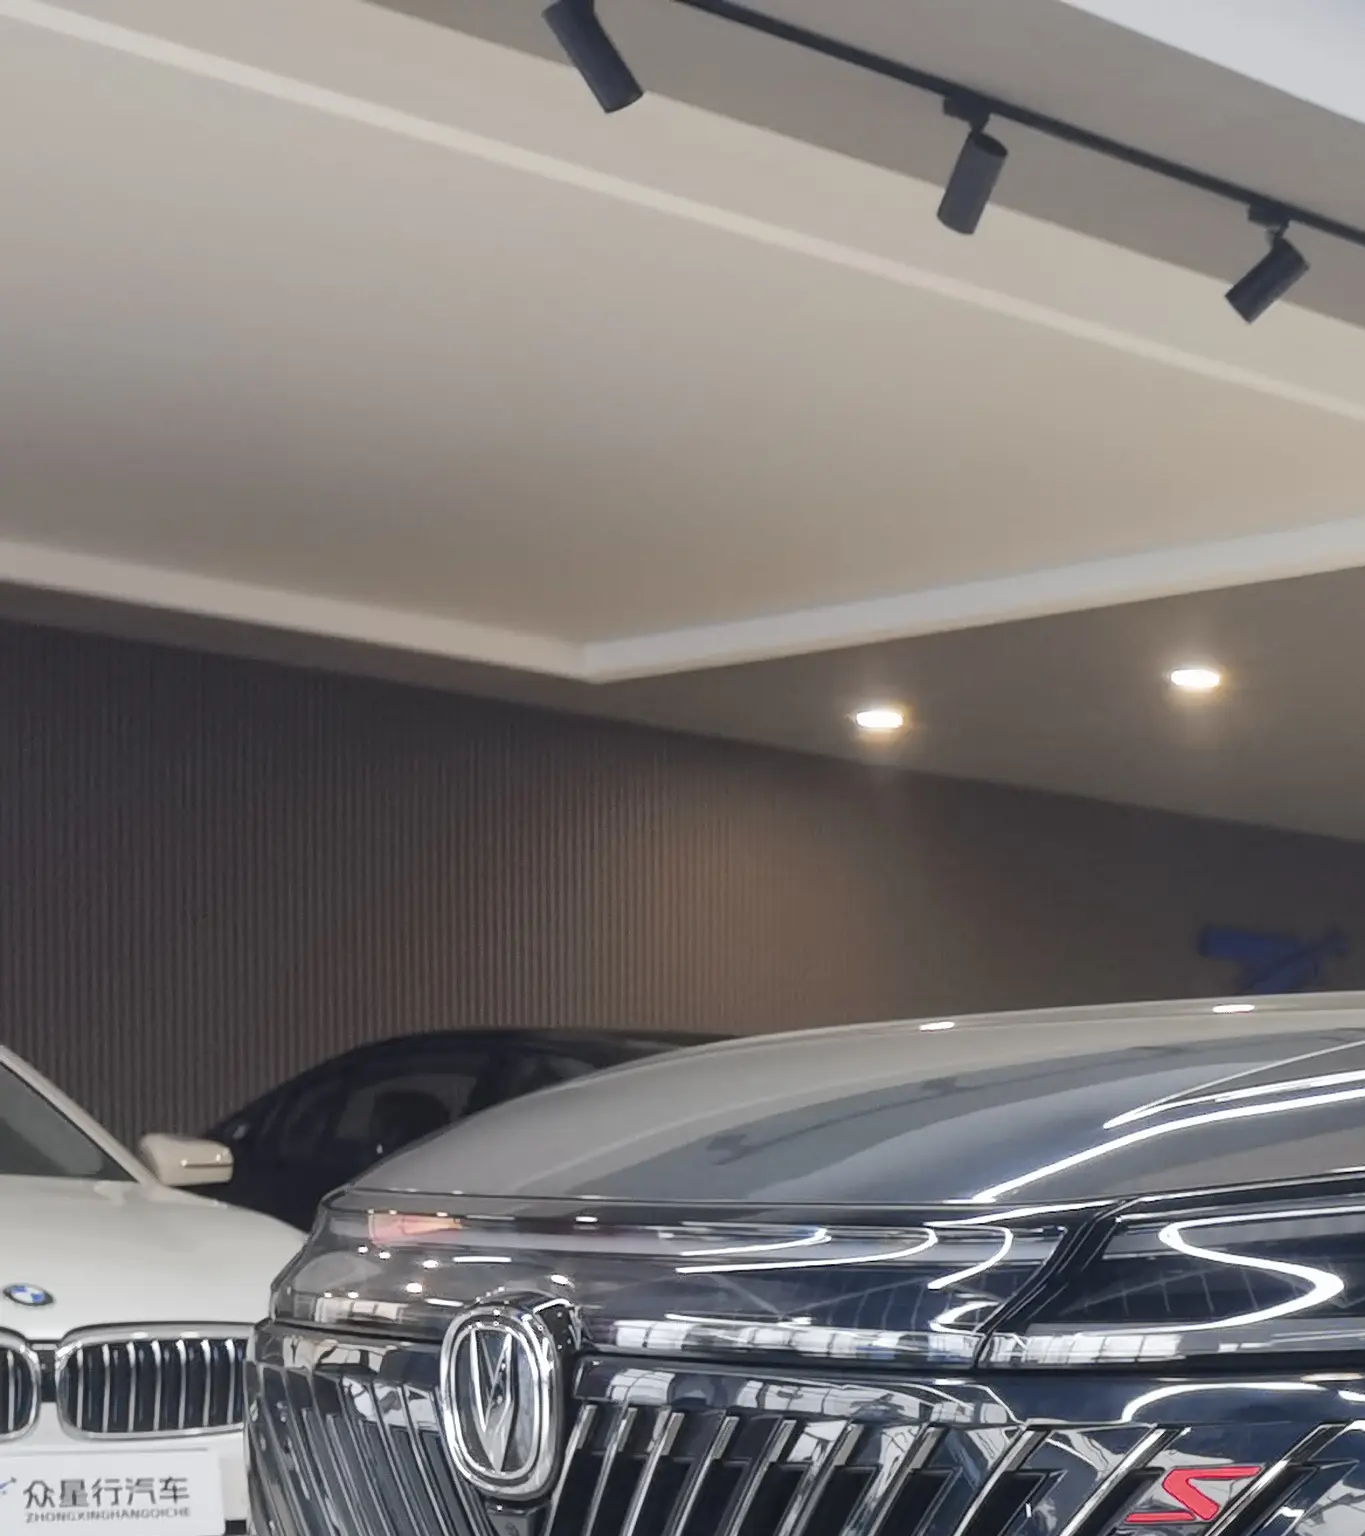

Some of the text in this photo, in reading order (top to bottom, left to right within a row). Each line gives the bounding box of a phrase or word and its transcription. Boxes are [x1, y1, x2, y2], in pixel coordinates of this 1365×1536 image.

[23, 1476, 190, 1509] 众星行汽车
